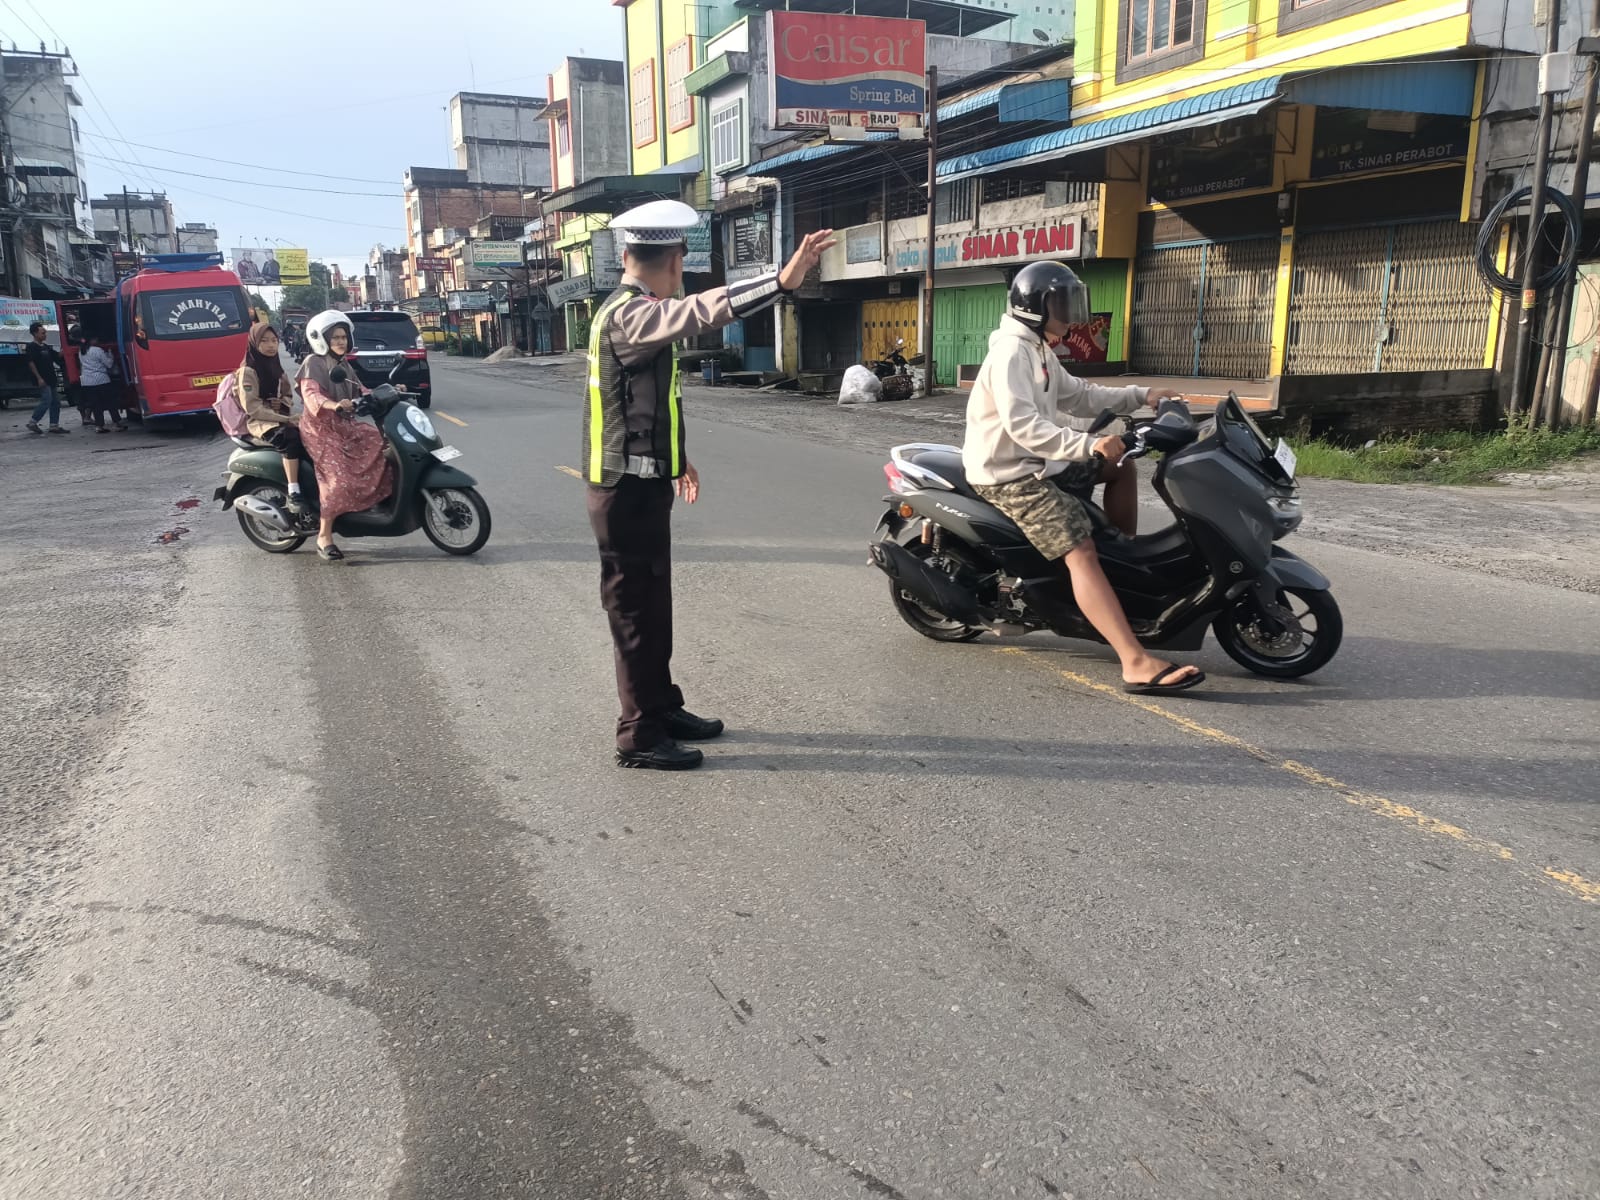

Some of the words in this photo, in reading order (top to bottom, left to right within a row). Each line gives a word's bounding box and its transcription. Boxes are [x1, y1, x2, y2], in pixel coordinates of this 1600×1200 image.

[781, 24, 911, 66] Caisar
[850, 86, 891, 105] Spring
[894, 88, 917, 104] Bed
[870, 113, 897, 124] RAPU
[1338, 160, 1356, 171] TK.
[1358, 153, 1392, 169] SINAR
[1395, 143, 1454, 163] PERABOT
[1180, 183, 1204, 196] SINAR
[1205, 177, 1246, 193] PERABOT
[896, 246, 919, 268] toko
[922, 240, 958, 270] ppuk
[962, 231, 1019, 261] SINAR
[1023, 223, 1075, 255] TANI
[168, 299, 227, 326] ALMAHYRA
[179, 321, 221, 331] TSABITA
